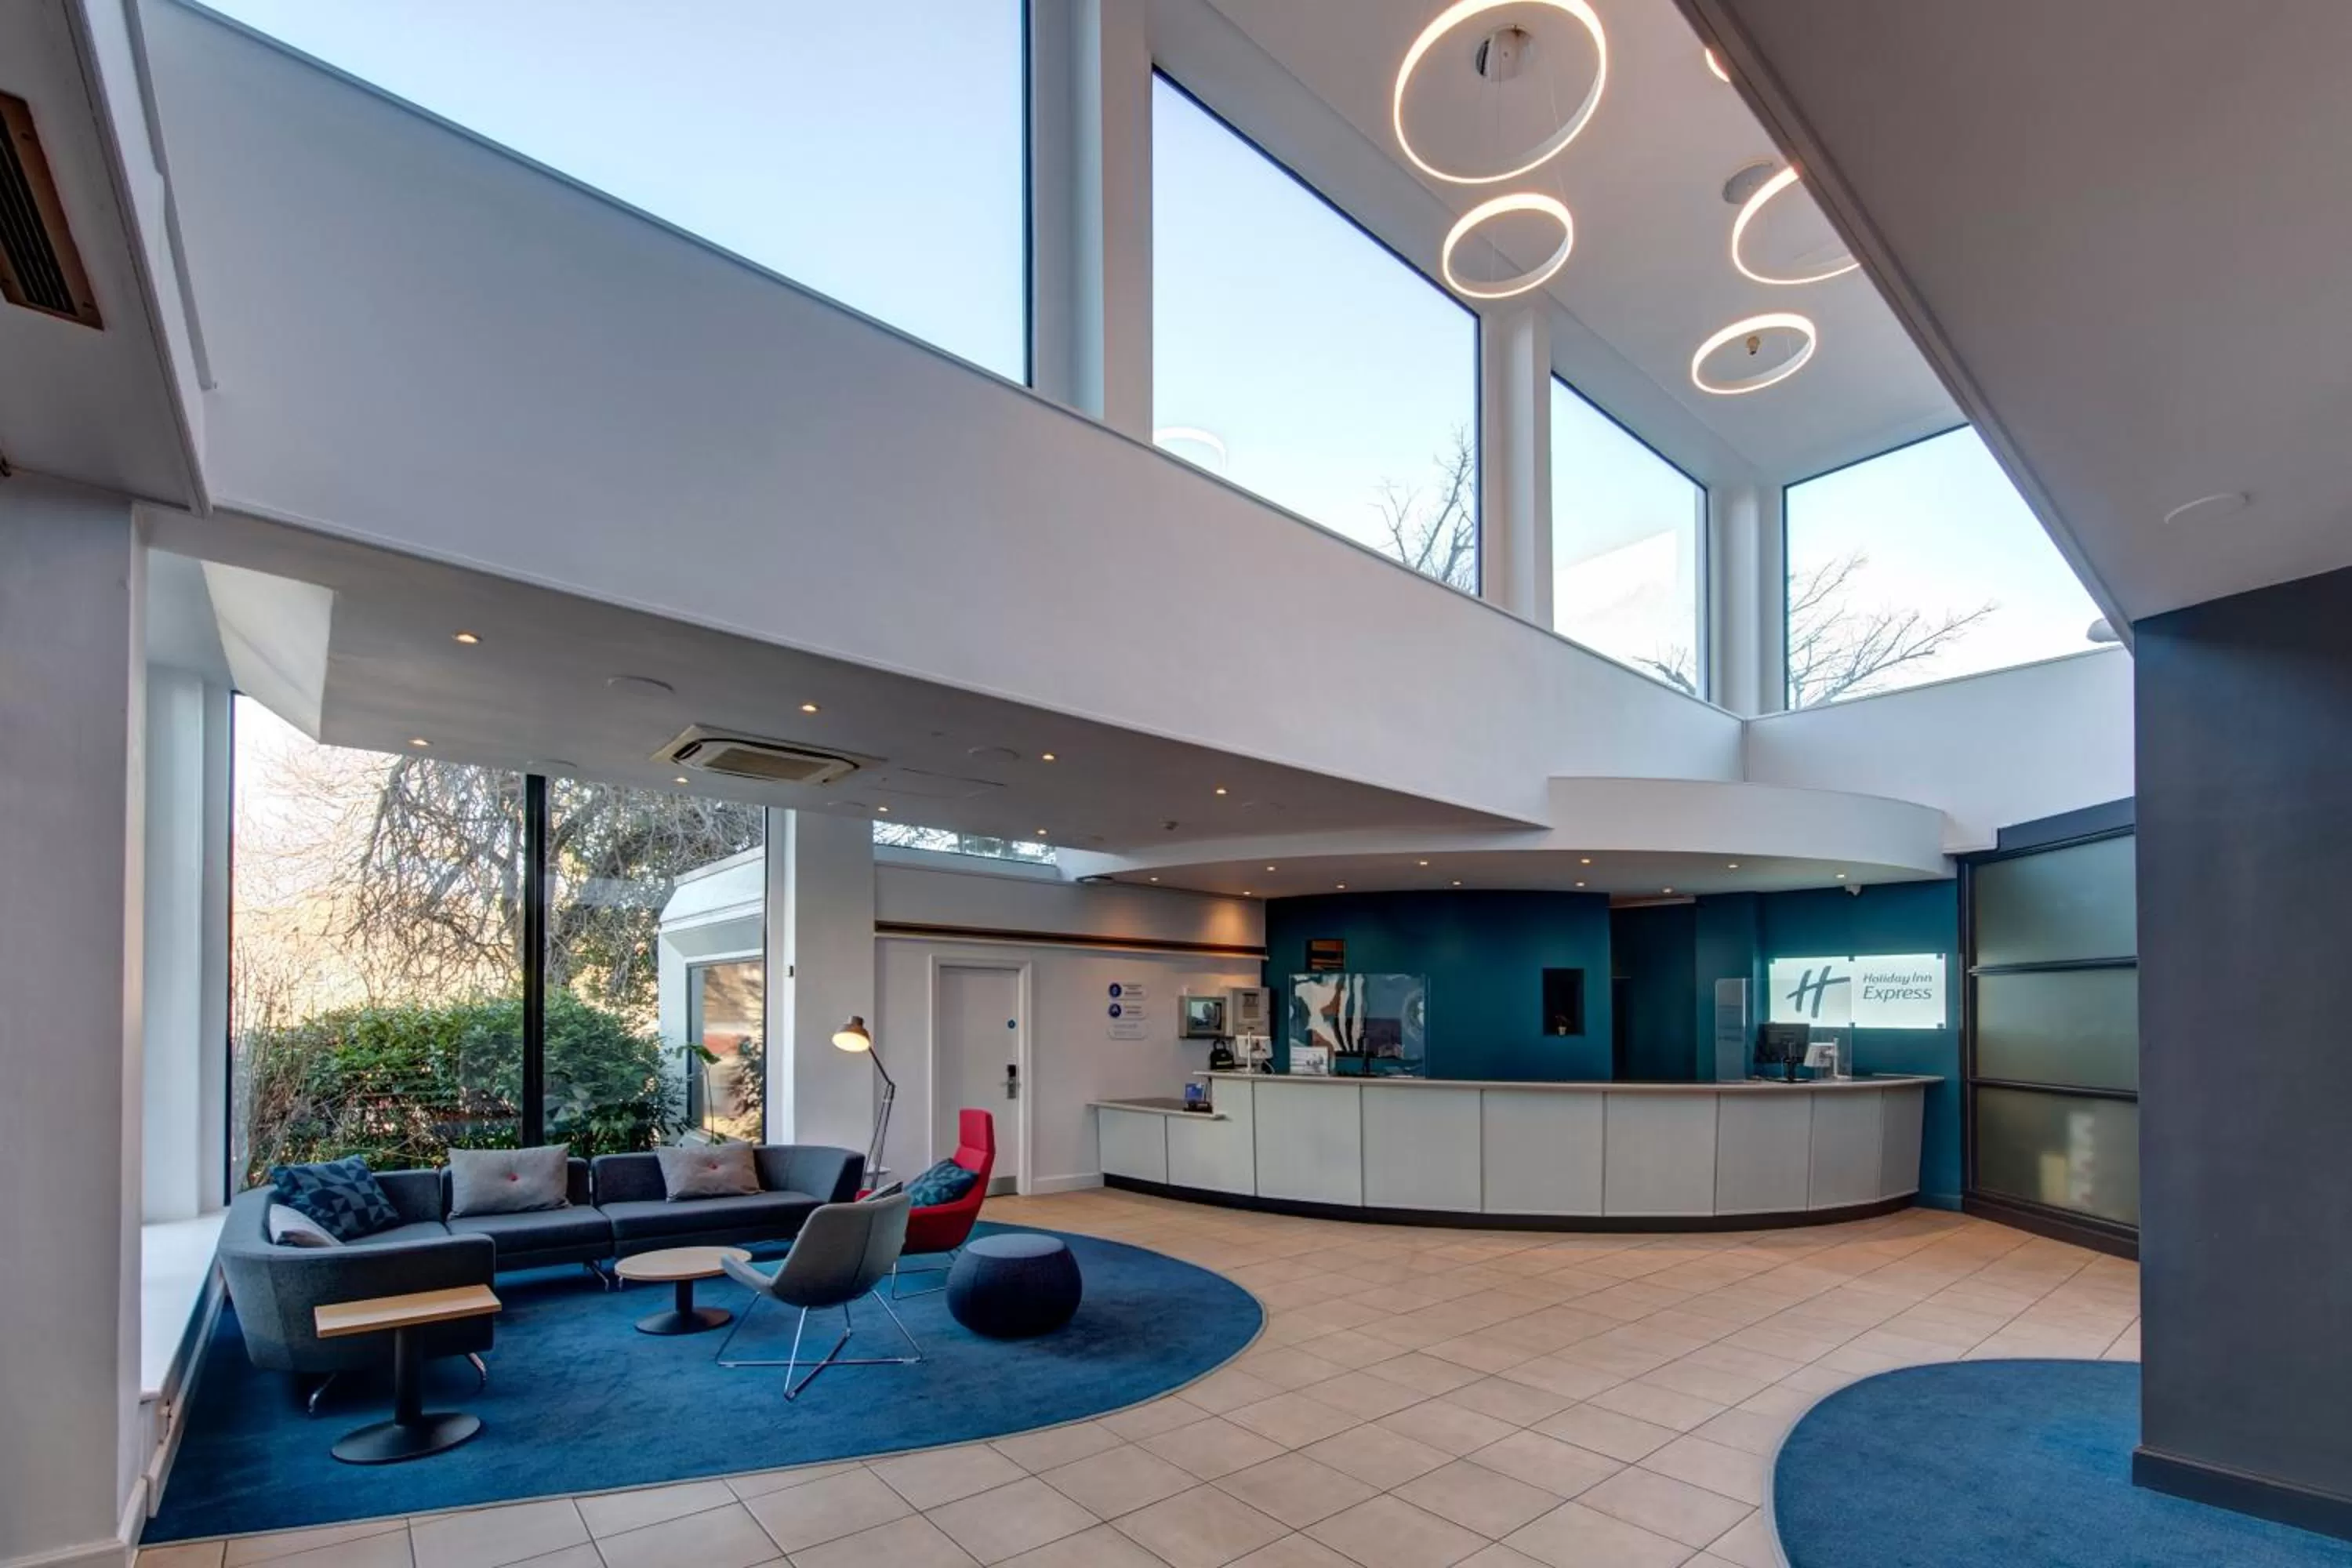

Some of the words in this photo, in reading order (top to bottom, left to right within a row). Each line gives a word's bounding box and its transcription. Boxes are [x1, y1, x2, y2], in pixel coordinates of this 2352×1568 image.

[1862, 972, 1911, 985] Holiday
[1911, 971, 1933, 982] Inn
[1862, 985, 1933, 1003] Express
